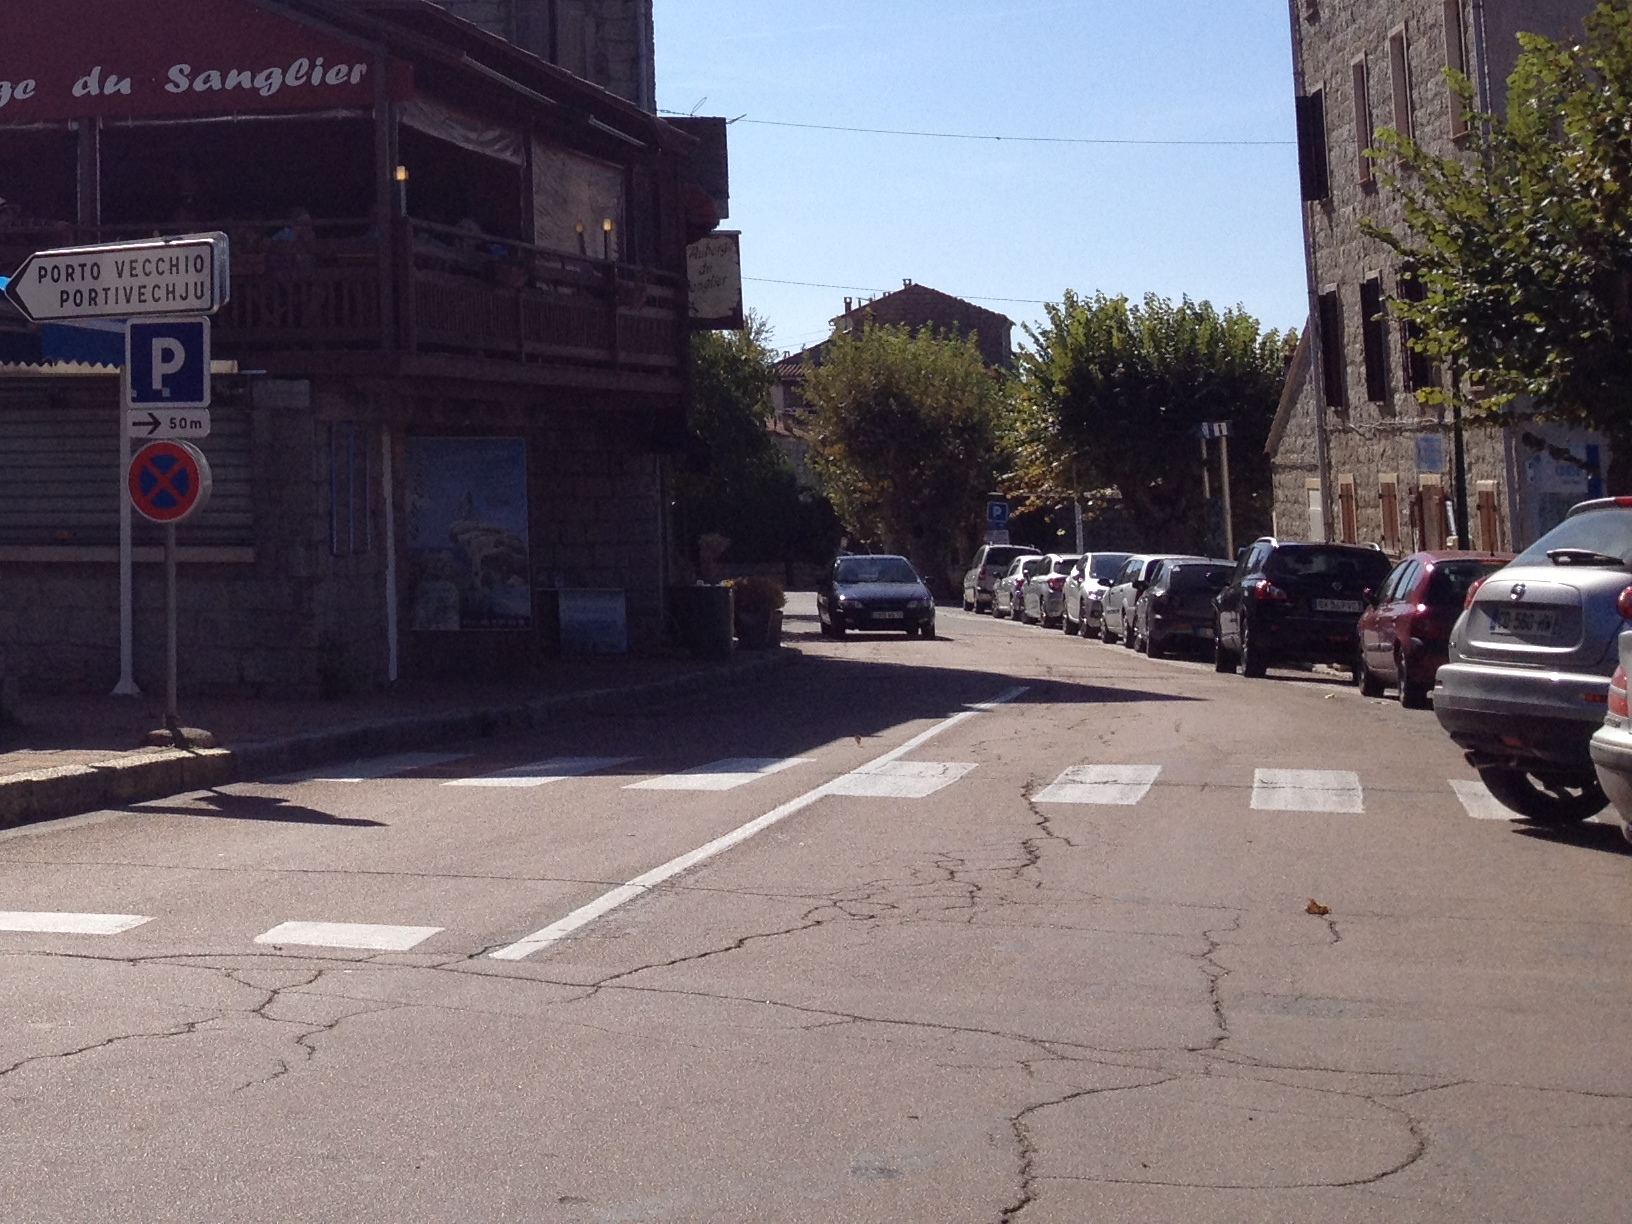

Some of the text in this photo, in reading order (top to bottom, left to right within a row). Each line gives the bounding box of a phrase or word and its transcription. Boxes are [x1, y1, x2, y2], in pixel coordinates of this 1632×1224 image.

[72, 66, 132, 98] du
[164, 57, 368, 96] Sanglier
[38, 254, 204, 284] PORTO VECCHIO
[60, 281, 204, 308] PORTIVECHJU
[151, 337, 185, 390] P
[169, 417, 202, 430] 50m
[992, 505, 1002, 518] P
